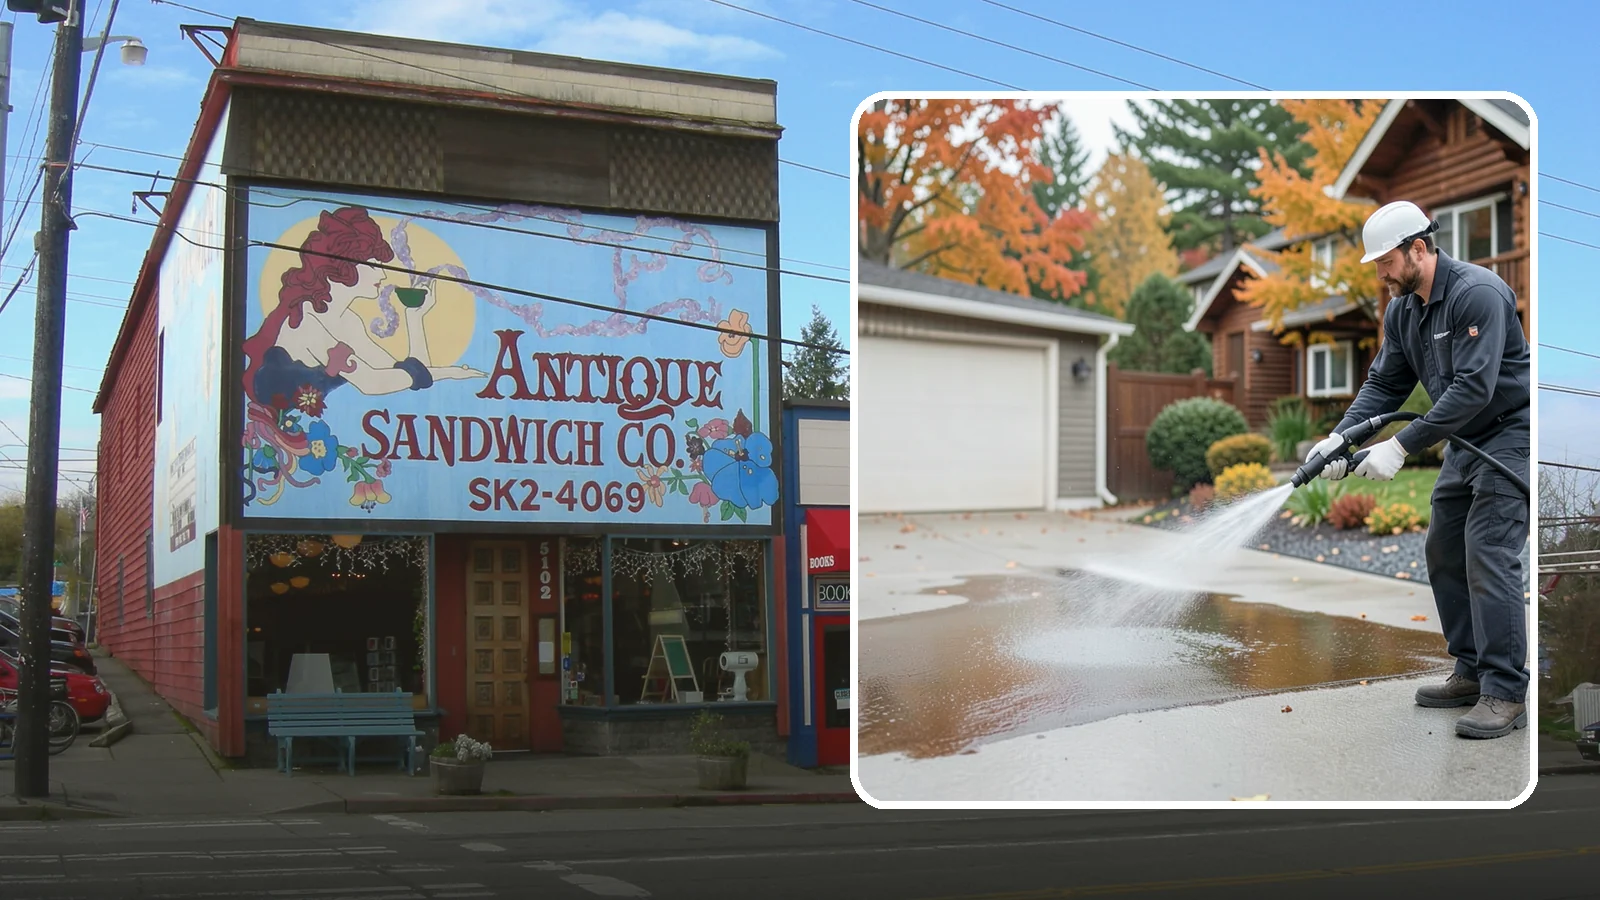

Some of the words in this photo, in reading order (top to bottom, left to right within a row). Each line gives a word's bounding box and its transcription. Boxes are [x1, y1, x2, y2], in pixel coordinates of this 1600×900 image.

[476, 329, 723, 420] ANTIQUE
[361, 409, 604, 467] SANDWICH
[617, 421, 685, 469] CO.
[468, 477, 646, 513] SK2-4069
[539, 541, 552, 600] 5102
[809, 555, 835, 569] BOOKS
